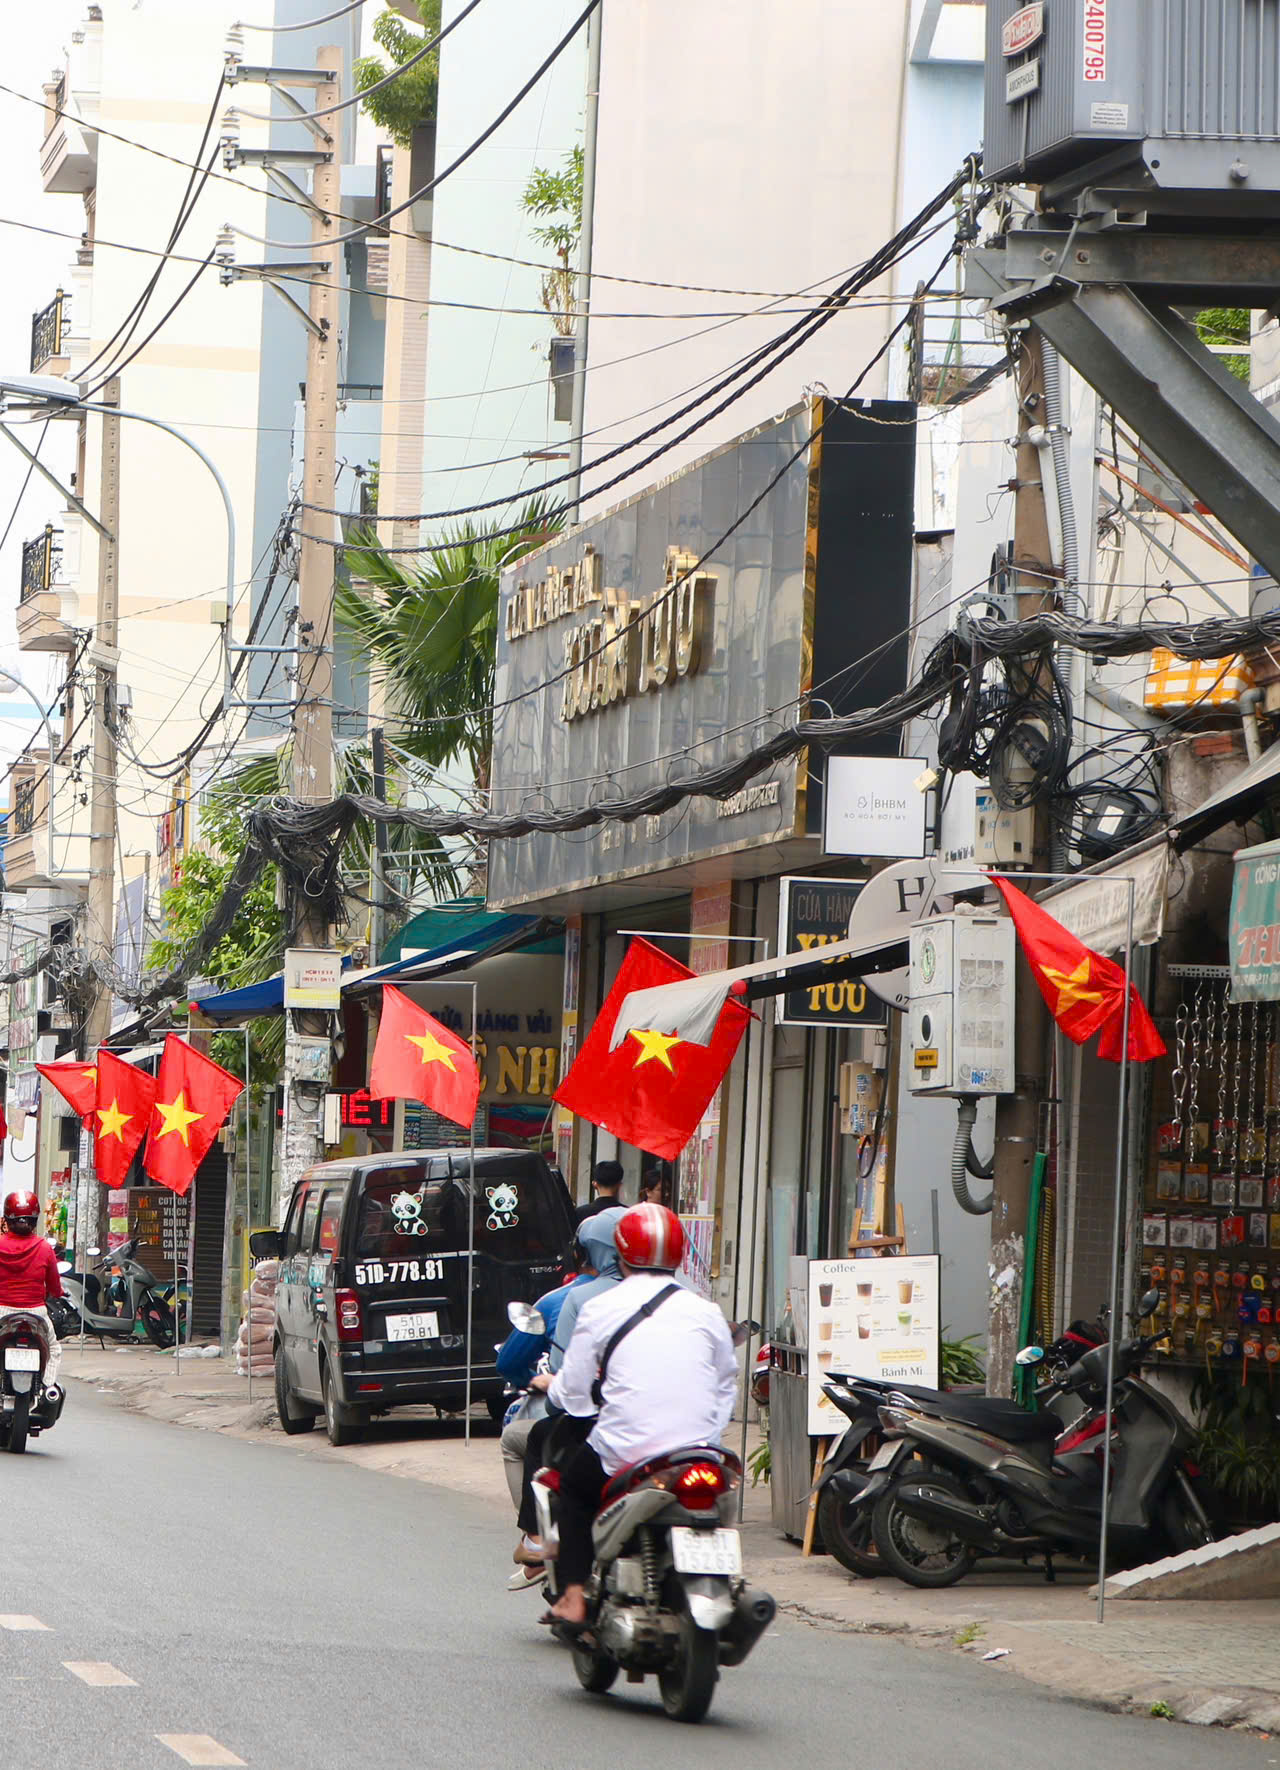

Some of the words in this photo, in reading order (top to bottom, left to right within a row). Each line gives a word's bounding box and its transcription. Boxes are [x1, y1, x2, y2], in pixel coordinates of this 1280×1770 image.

[874, 798, 906, 809] BHBM
[894, 877, 927, 913] H
[158, 1197, 188, 1206] COTON
[355, 1260, 444, 1286] 51D-778.81
[823, 1263, 856, 1274] Coffee
[881, 1367, 908, 1378] Bánh
